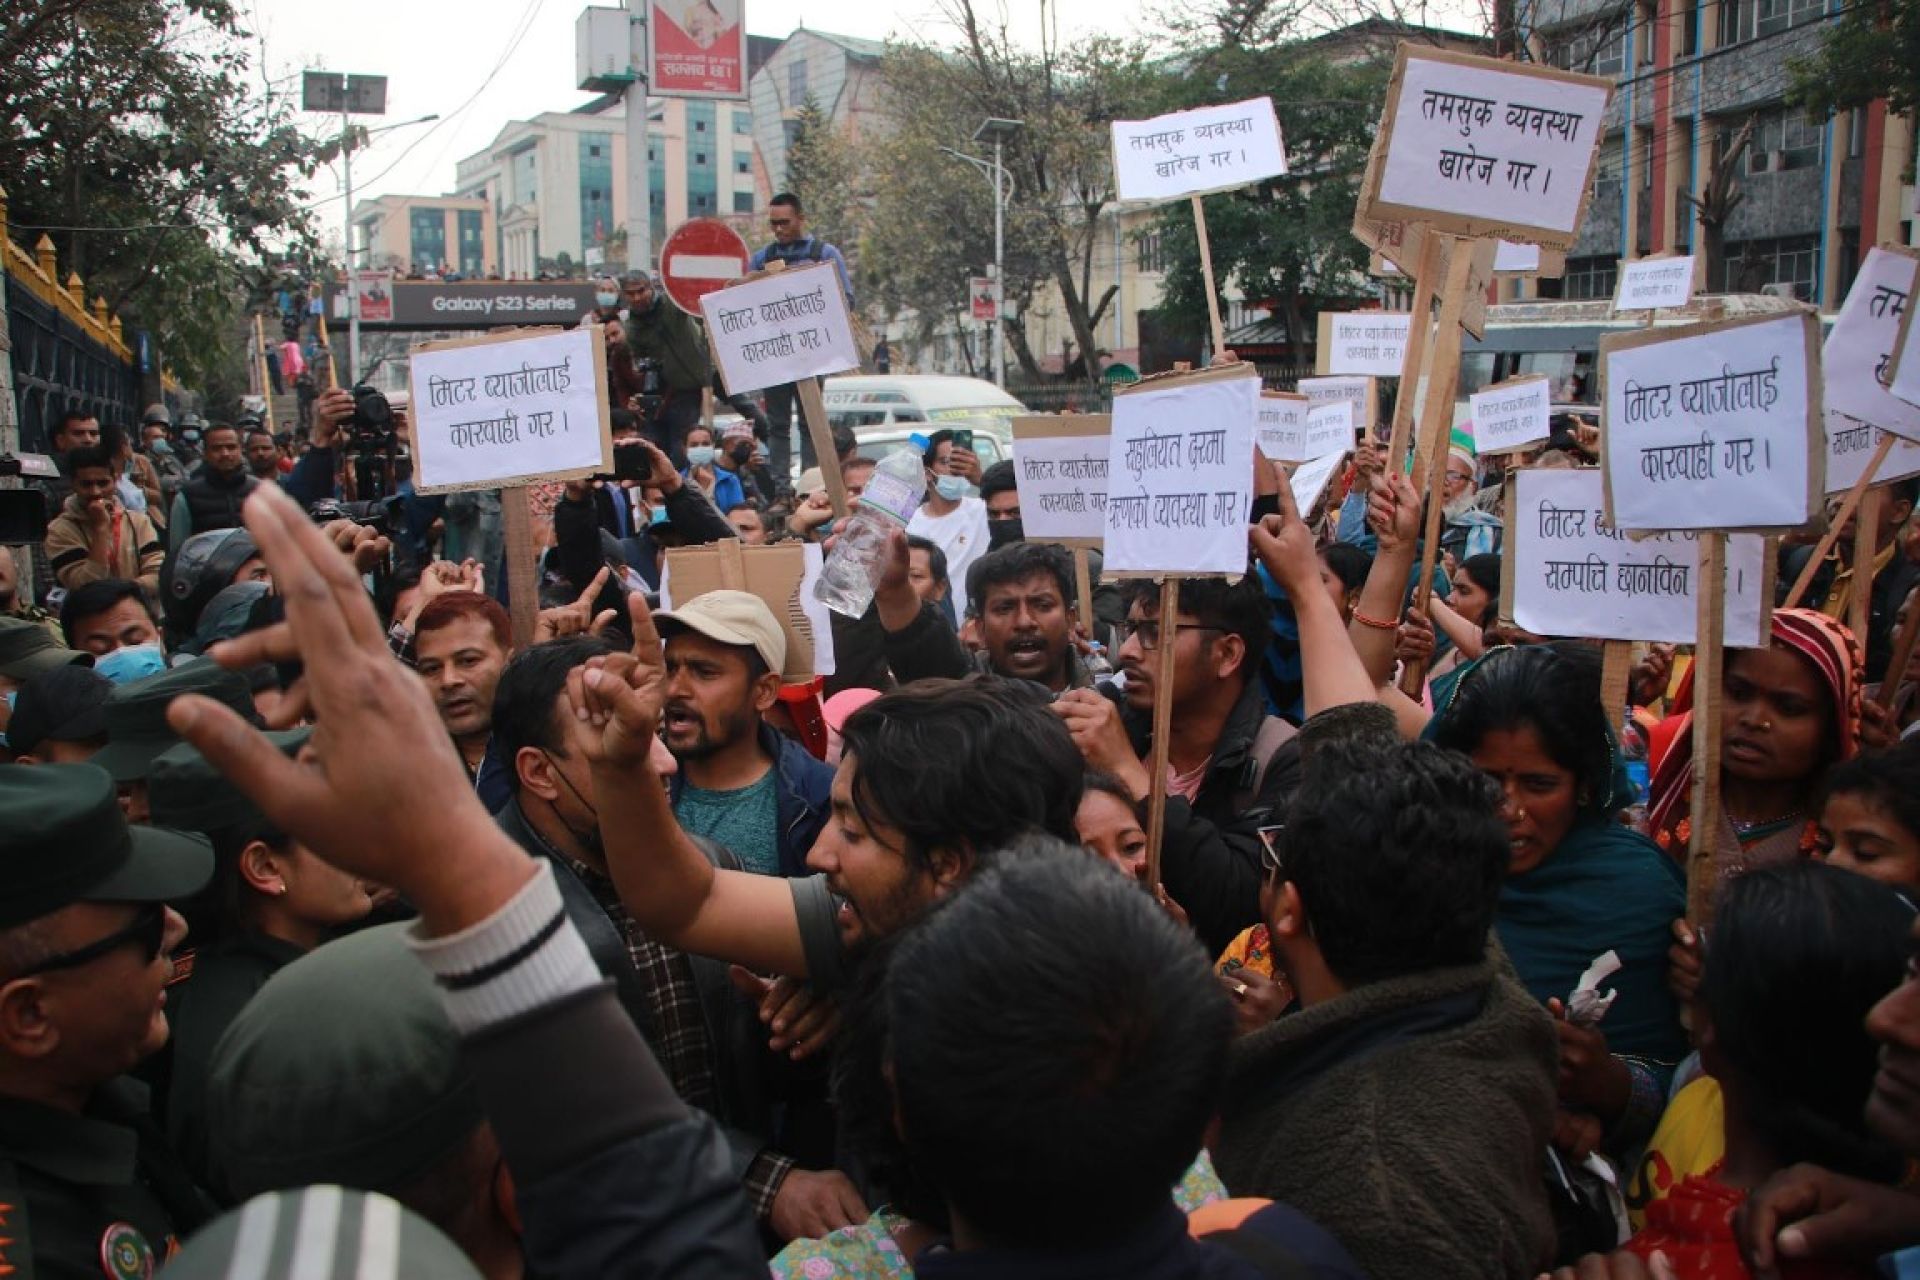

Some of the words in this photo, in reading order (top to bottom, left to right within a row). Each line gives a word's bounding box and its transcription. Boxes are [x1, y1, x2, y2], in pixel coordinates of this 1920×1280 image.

[1422, 89, 1496, 137] तमसुक
[1506, 103, 1583, 142] व्यवस्था
[1129, 129, 1186, 153] तमसुक
[1194, 117, 1252, 140] व्यवस्था
[1156, 154, 1201, 178] खारेज
[1208, 149, 1232, 169] गर
[1439, 143, 1497, 185] खारेज
[1507, 160, 1537, 192] गर
[433, 296, 491, 314] Galaxy
[496, 296, 521, 311] S23
[526, 295, 576, 311] Series
[718, 307, 757, 334] मिटर
[798, 327, 821, 350] गर
[428, 374, 477, 407] मिटर
[1623, 379, 1672, 424] मिटर
[450, 409, 520, 449] कारवाही
[528, 411, 554, 438] गर
[1023, 455, 1055, 480] मिटर
[1125, 426, 1182, 482] सहुलियत
[1188, 430, 1226, 471] दरमा
[1641, 430, 1716, 483] कारवाही
[1724, 437, 1755, 476] गर
[1154, 492, 1208, 529] व्यवस्था
[1213, 491, 1237, 528] गर
[1538, 500, 1586, 539] मिटर
